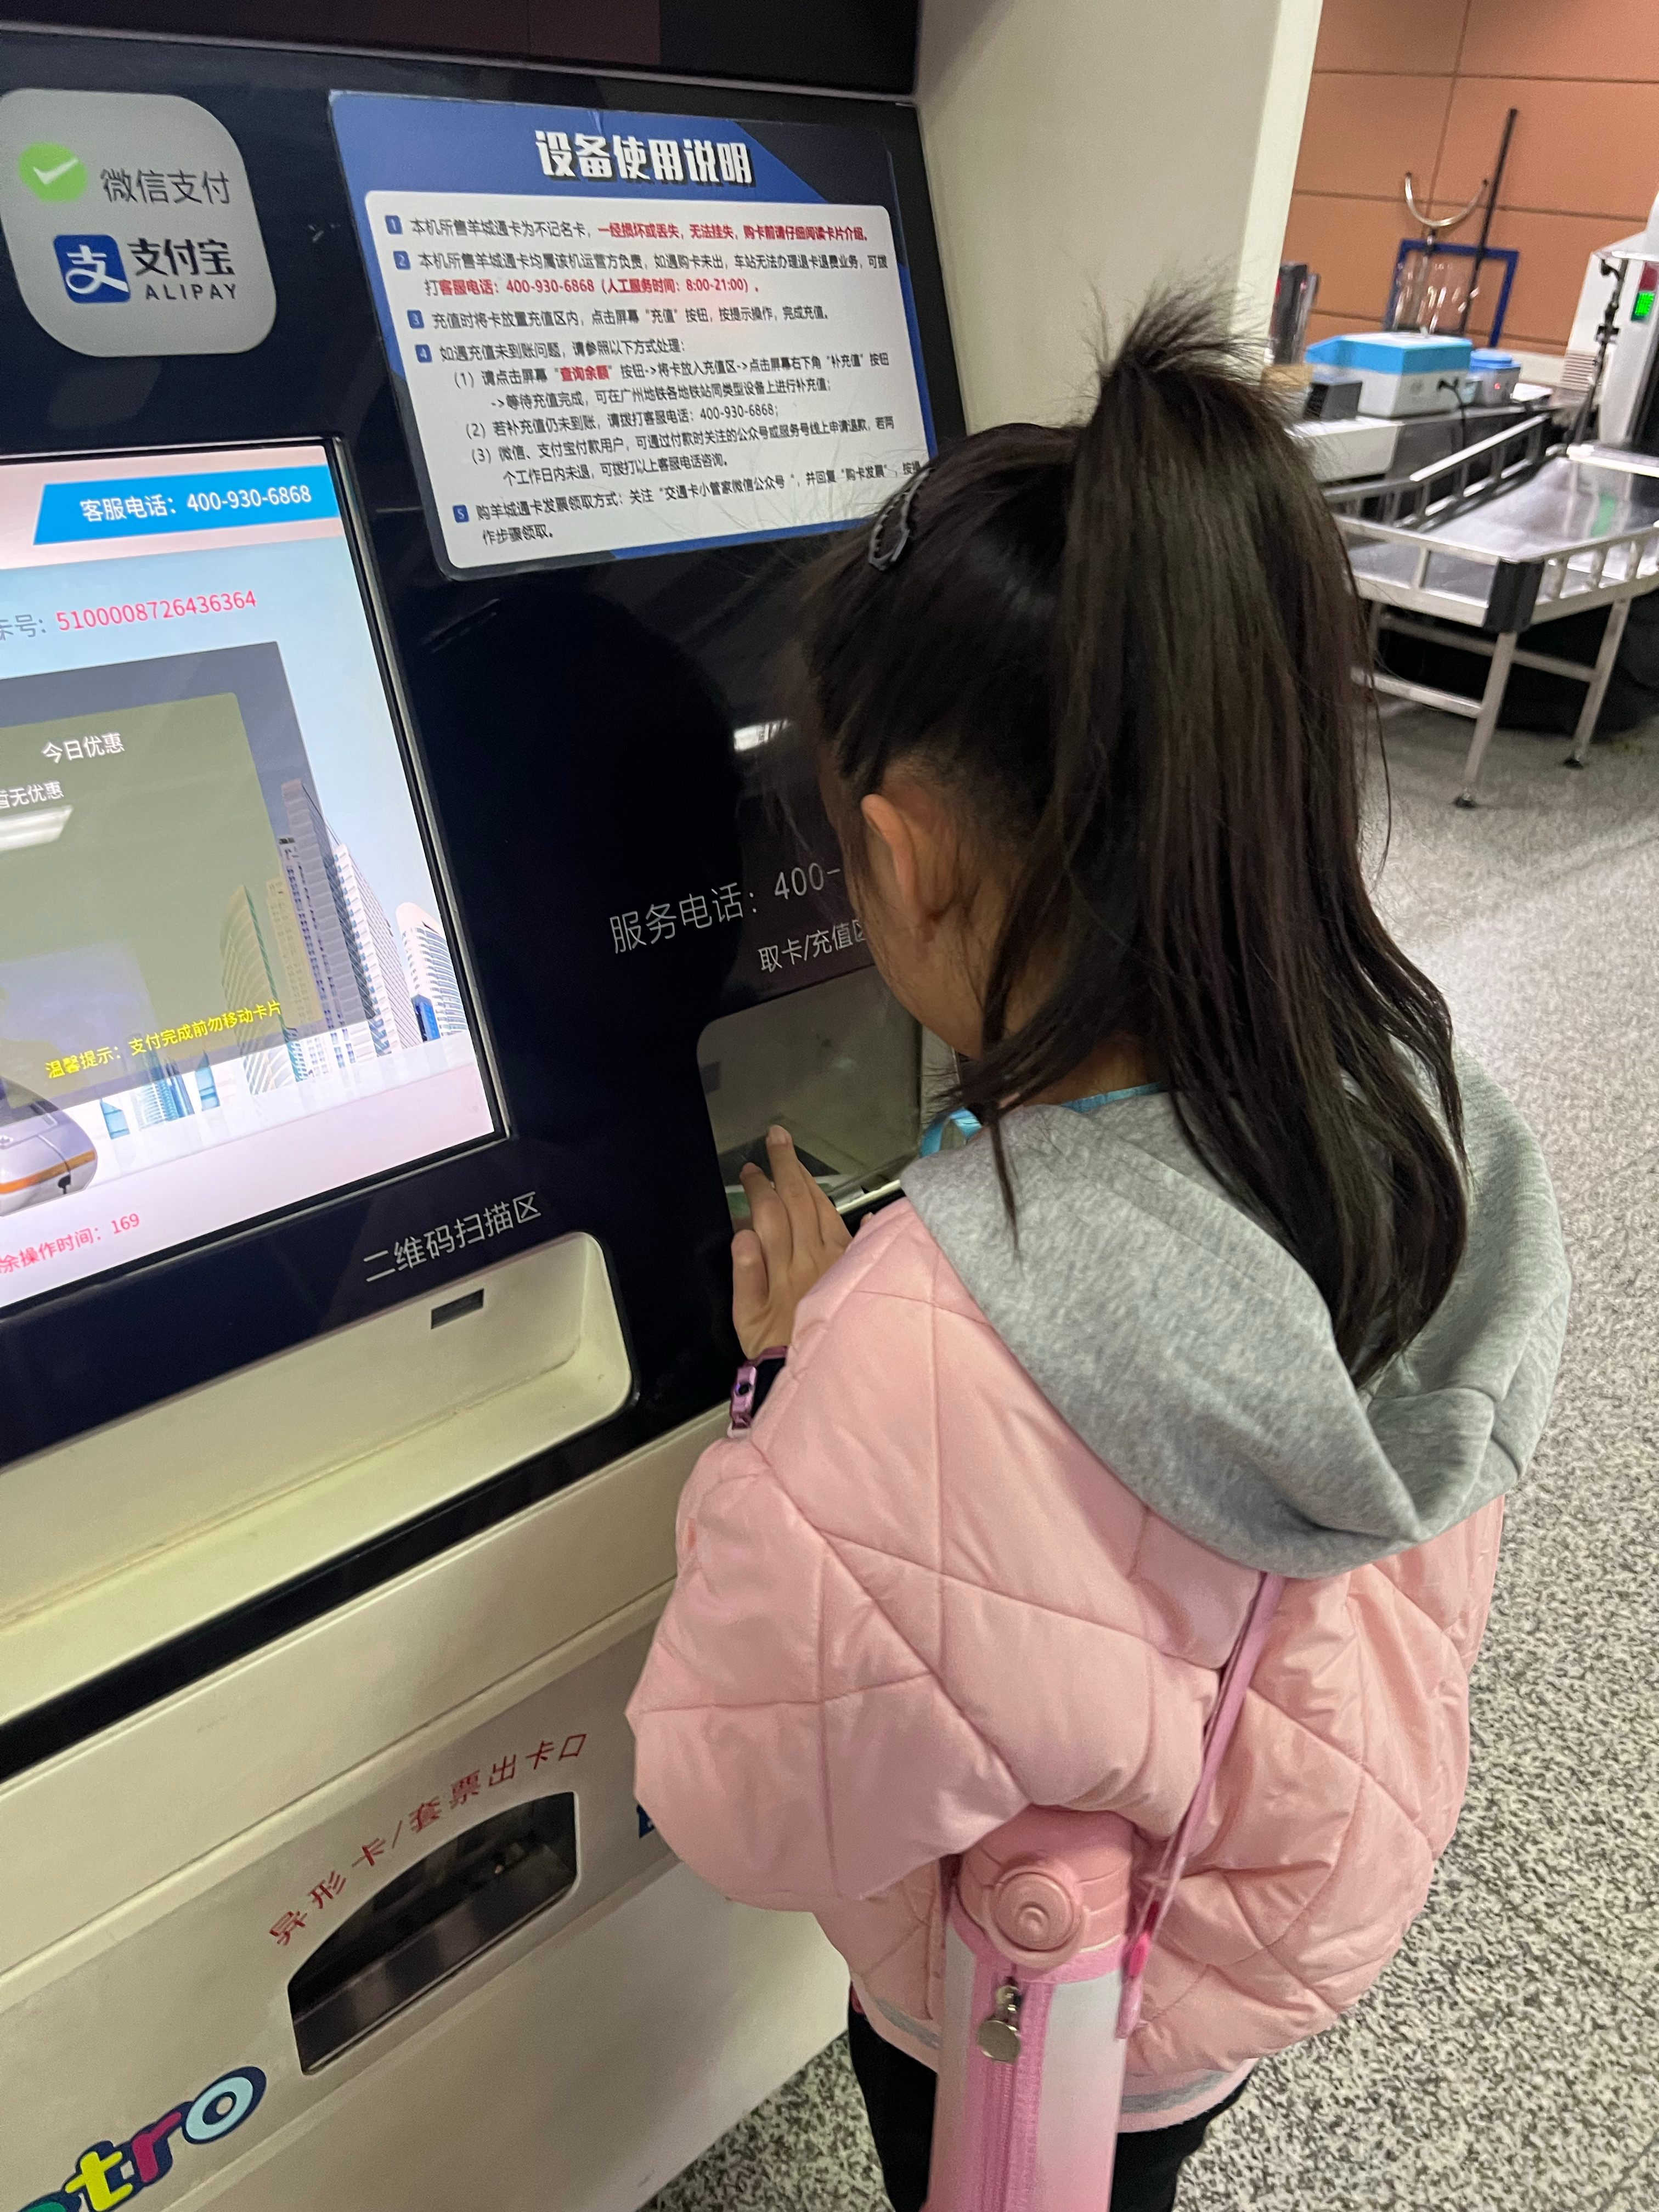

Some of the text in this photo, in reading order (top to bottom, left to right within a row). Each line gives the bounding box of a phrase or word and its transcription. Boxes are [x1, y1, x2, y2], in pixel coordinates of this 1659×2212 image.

[535, 129, 754, 185] 设备使用说明
[100, 167, 230, 205] 微信支付
[128, 237, 235, 276] 支付宝
[145, 283, 236, 301] ALIPAY
[80, 484, 312, 522] 客服电话：400-930-6868
[482, 523, 554, 546] 作步骤领取。
[41, 731, 126, 764] 今日优惠
[45, 999, 282, 1080] 温馨提示：支付完成前勿移动卡片
[363, 1191, 541, 1282] 二维码扫描区
[269, 1734, 587, 1946] 异形卡/套票出卡口
[16, 2066, 267, 2212] tro
